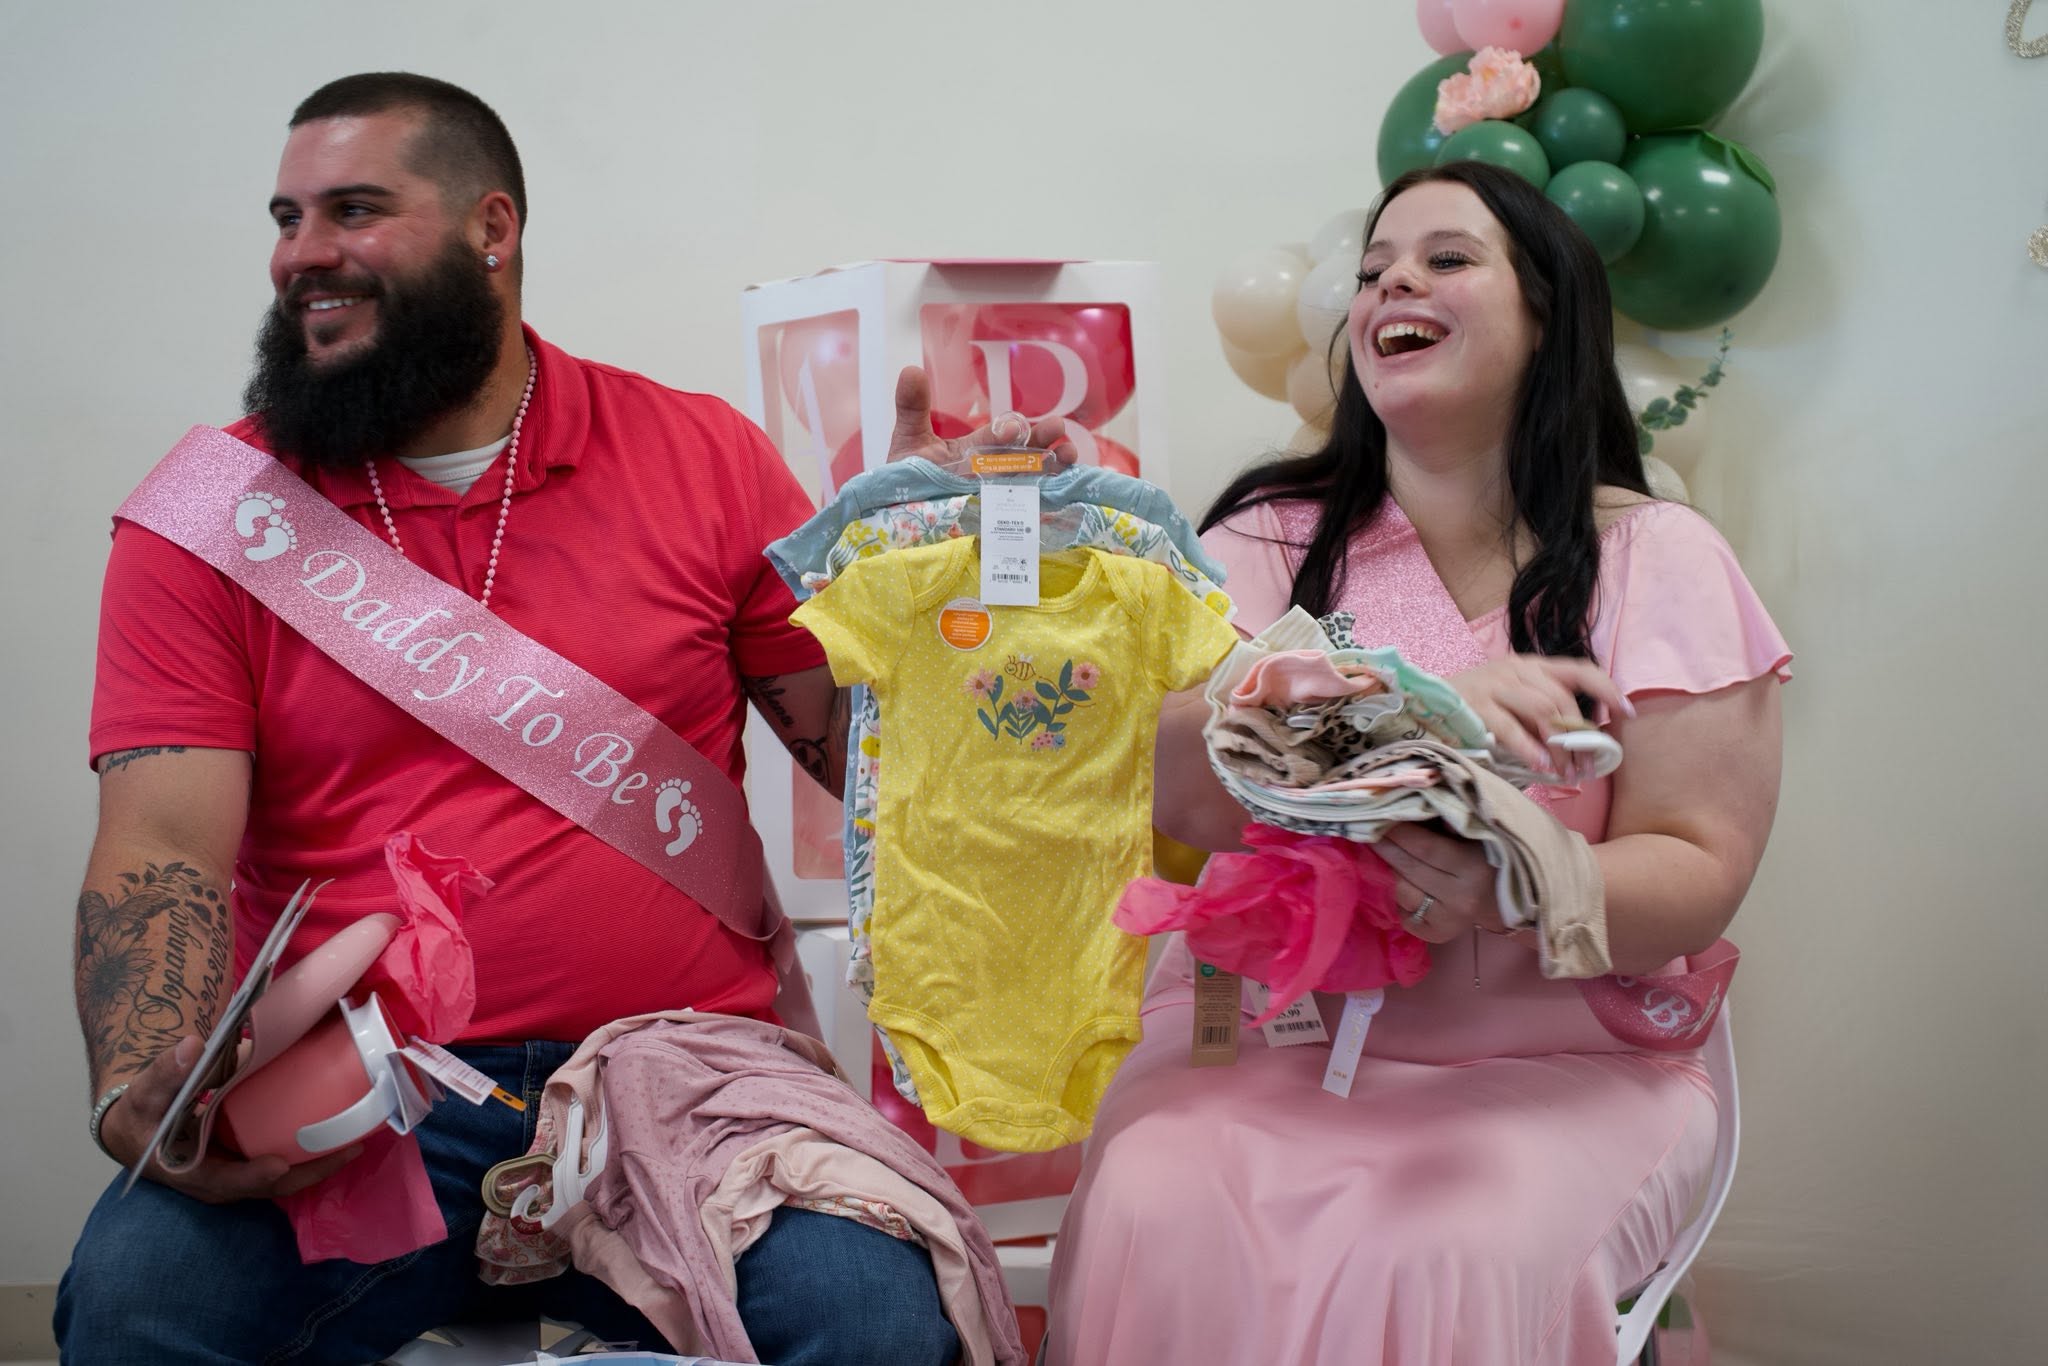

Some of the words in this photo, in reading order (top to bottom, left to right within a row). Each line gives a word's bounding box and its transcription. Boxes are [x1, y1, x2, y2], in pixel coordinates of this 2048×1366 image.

[299, 549, 486, 702] Daddy
[489, 674, 565, 748] To
[570, 732, 650, 805] Be
[133, 906, 204, 1034] Topanga
